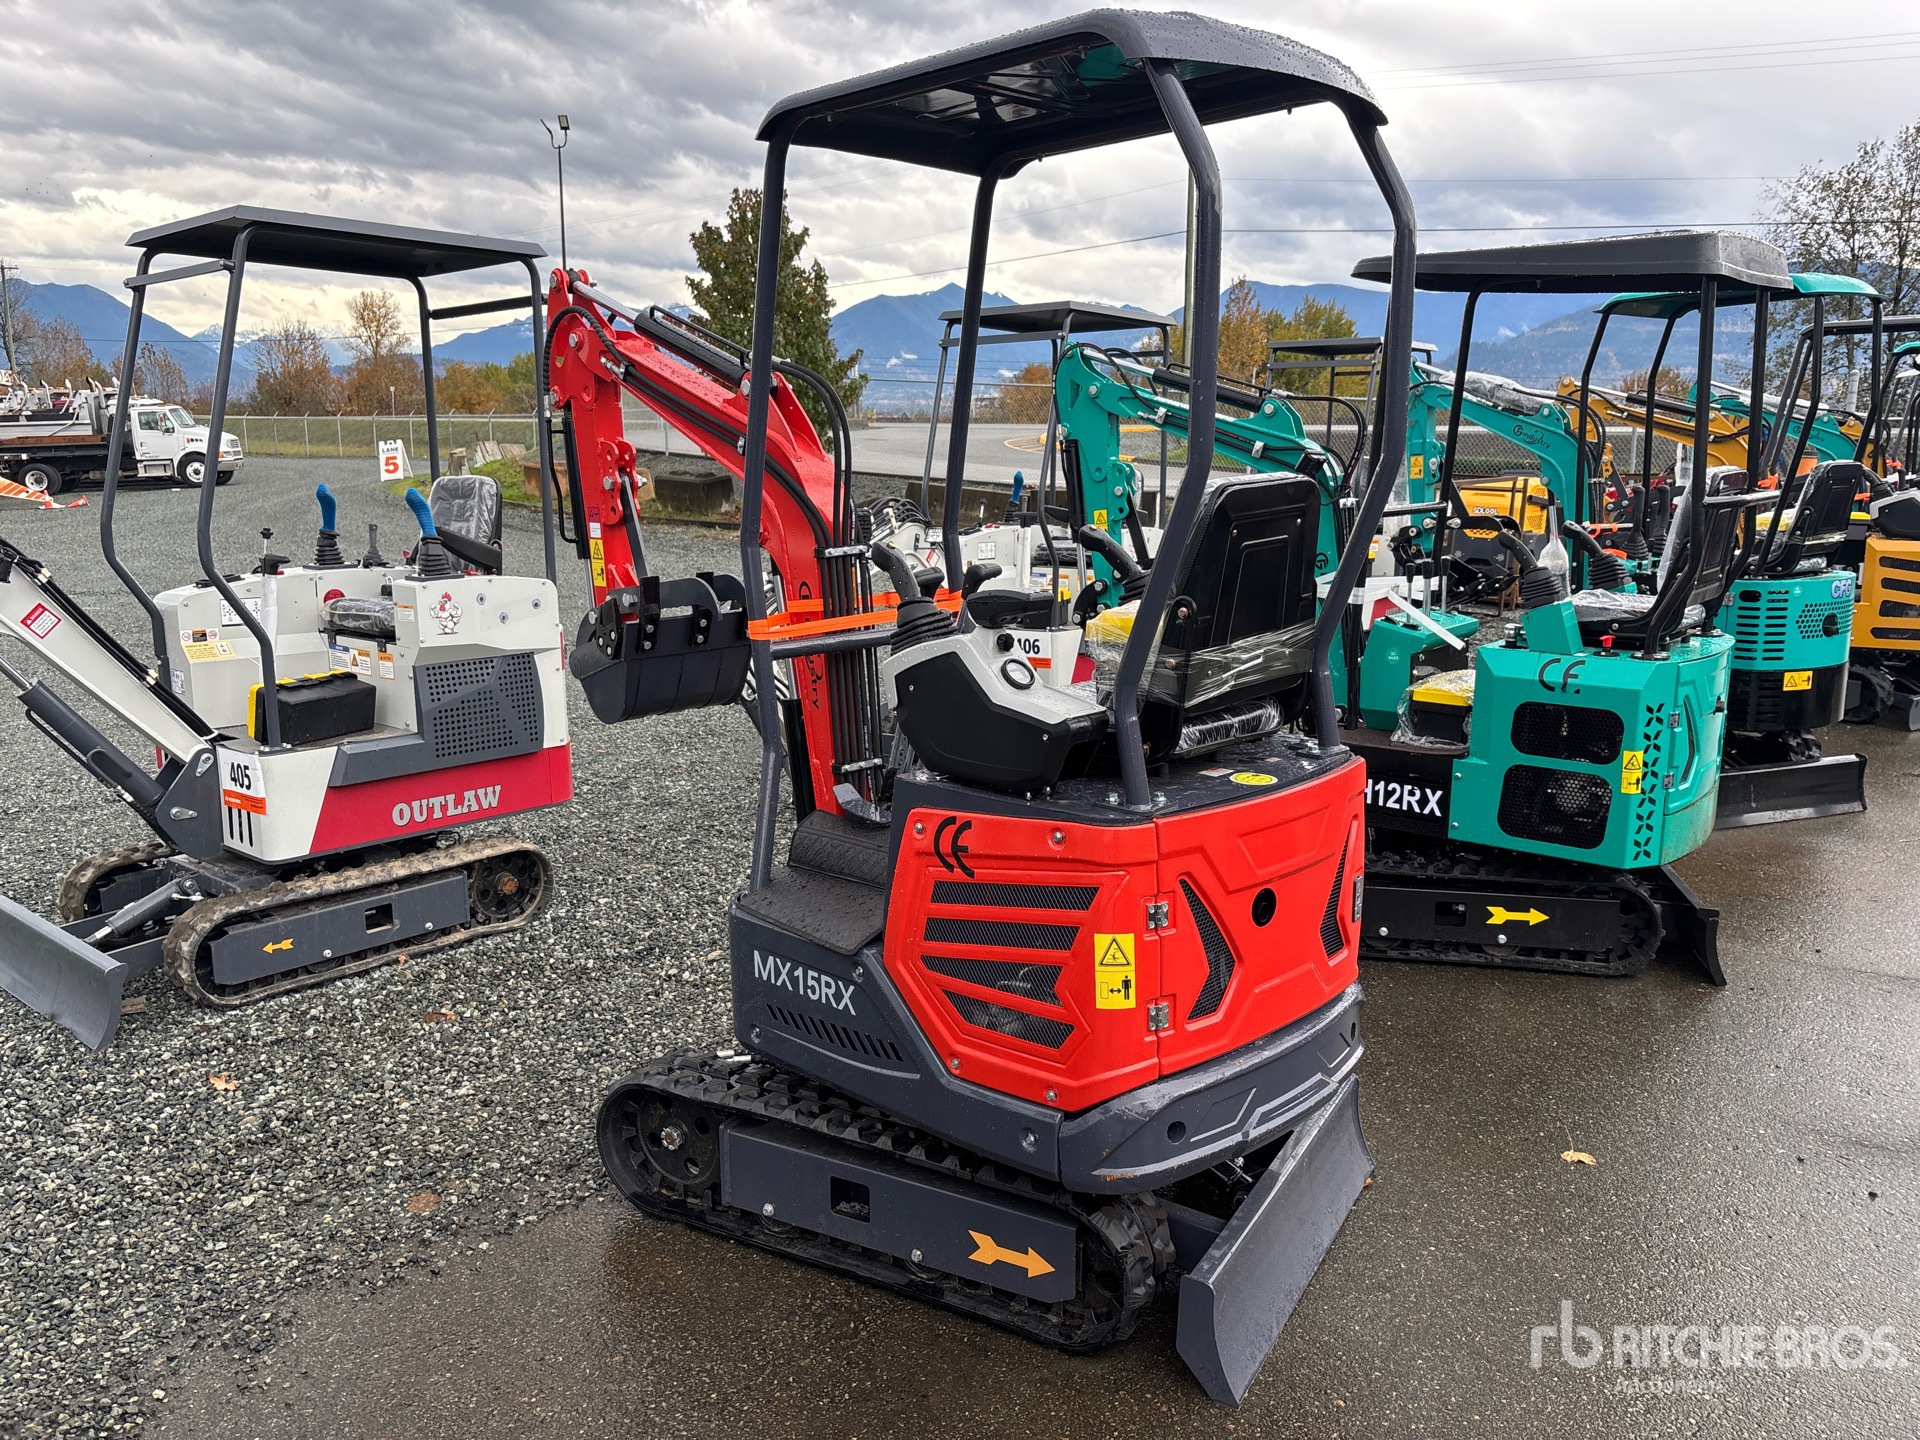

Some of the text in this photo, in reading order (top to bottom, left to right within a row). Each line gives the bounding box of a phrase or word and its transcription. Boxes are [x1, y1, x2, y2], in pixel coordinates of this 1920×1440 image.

[384, 455, 400, 475] 5
[1831, 579, 1852, 599] CFG
[230, 762, 252, 790] 405
[392, 785, 502, 826] OUTLAW
[933, 816, 975, 879] CE
[753, 949, 857, 1016] MX15RX
